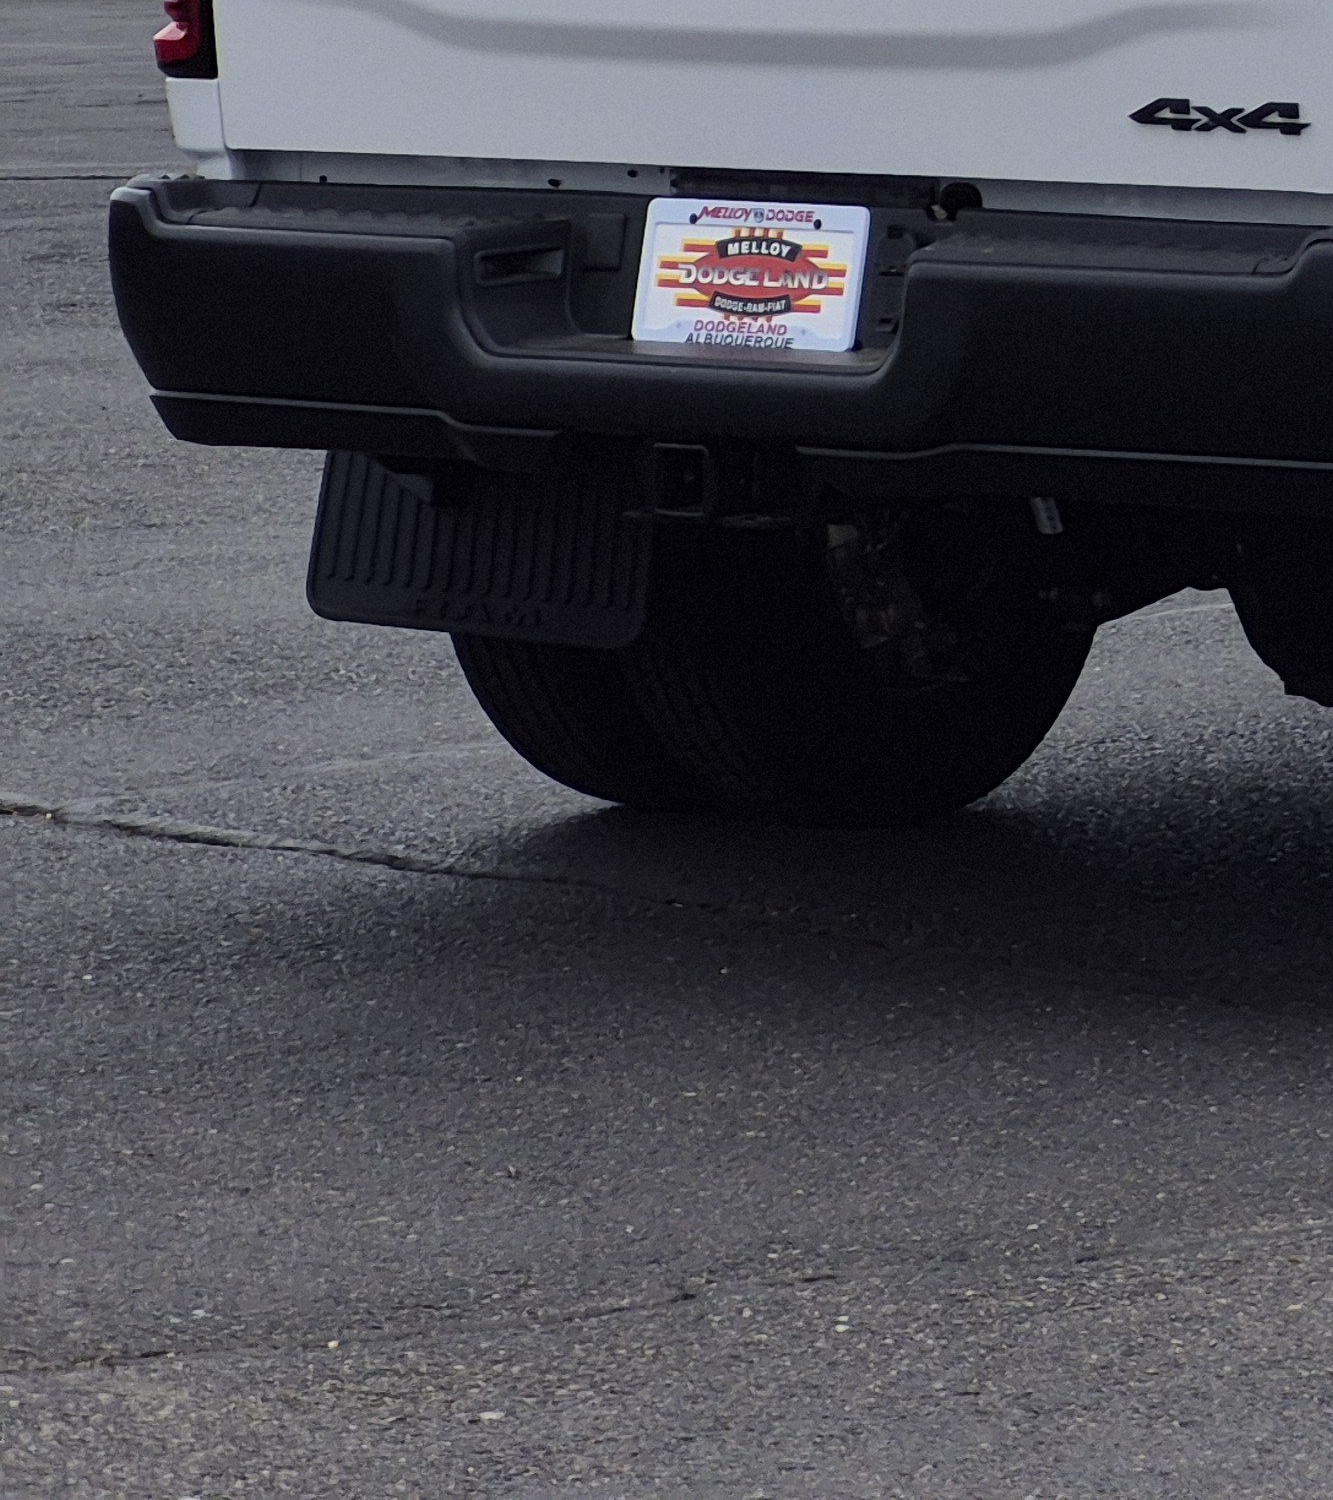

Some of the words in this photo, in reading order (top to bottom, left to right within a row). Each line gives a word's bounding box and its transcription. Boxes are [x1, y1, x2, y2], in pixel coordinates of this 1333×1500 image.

[1127, 96, 1312, 136] 4x4
[696, 205, 752, 223] MELLOY
[765, 208, 816, 223] DODGE
[727, 240, 792, 258] MELLOY
[693, 319, 788, 336] DODGELAND
[684, 331, 795, 350] ALBUQUERQUE
